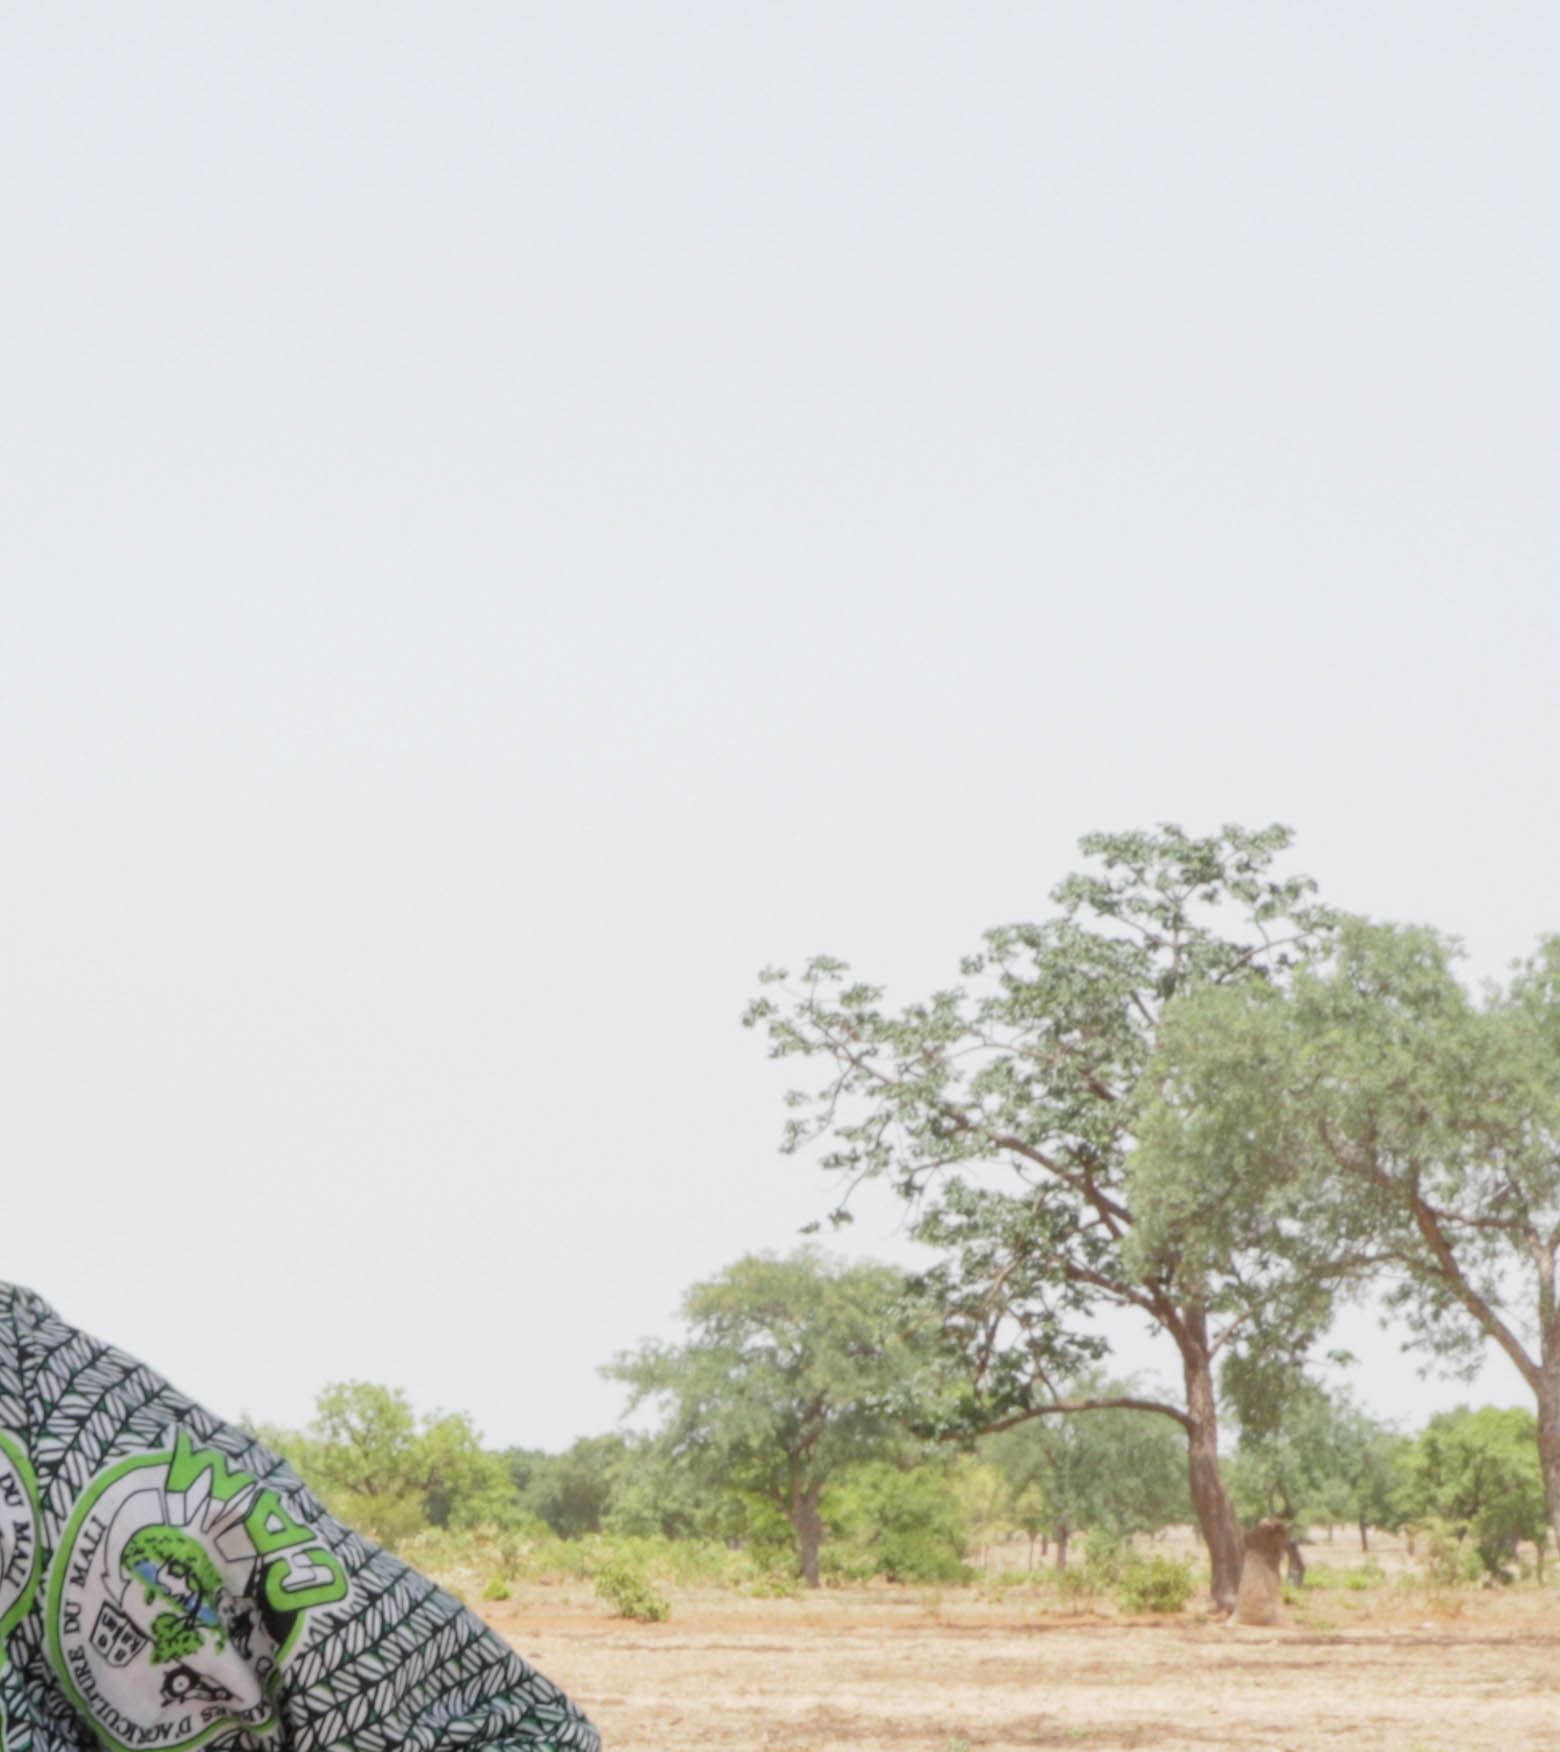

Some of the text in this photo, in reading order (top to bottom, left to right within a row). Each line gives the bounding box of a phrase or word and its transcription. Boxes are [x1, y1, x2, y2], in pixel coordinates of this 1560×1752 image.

[4, 1520, 33, 1589] MALI
[69, 1515, 107, 1589] MALI
[63, 1601, 83, 1634] DU
